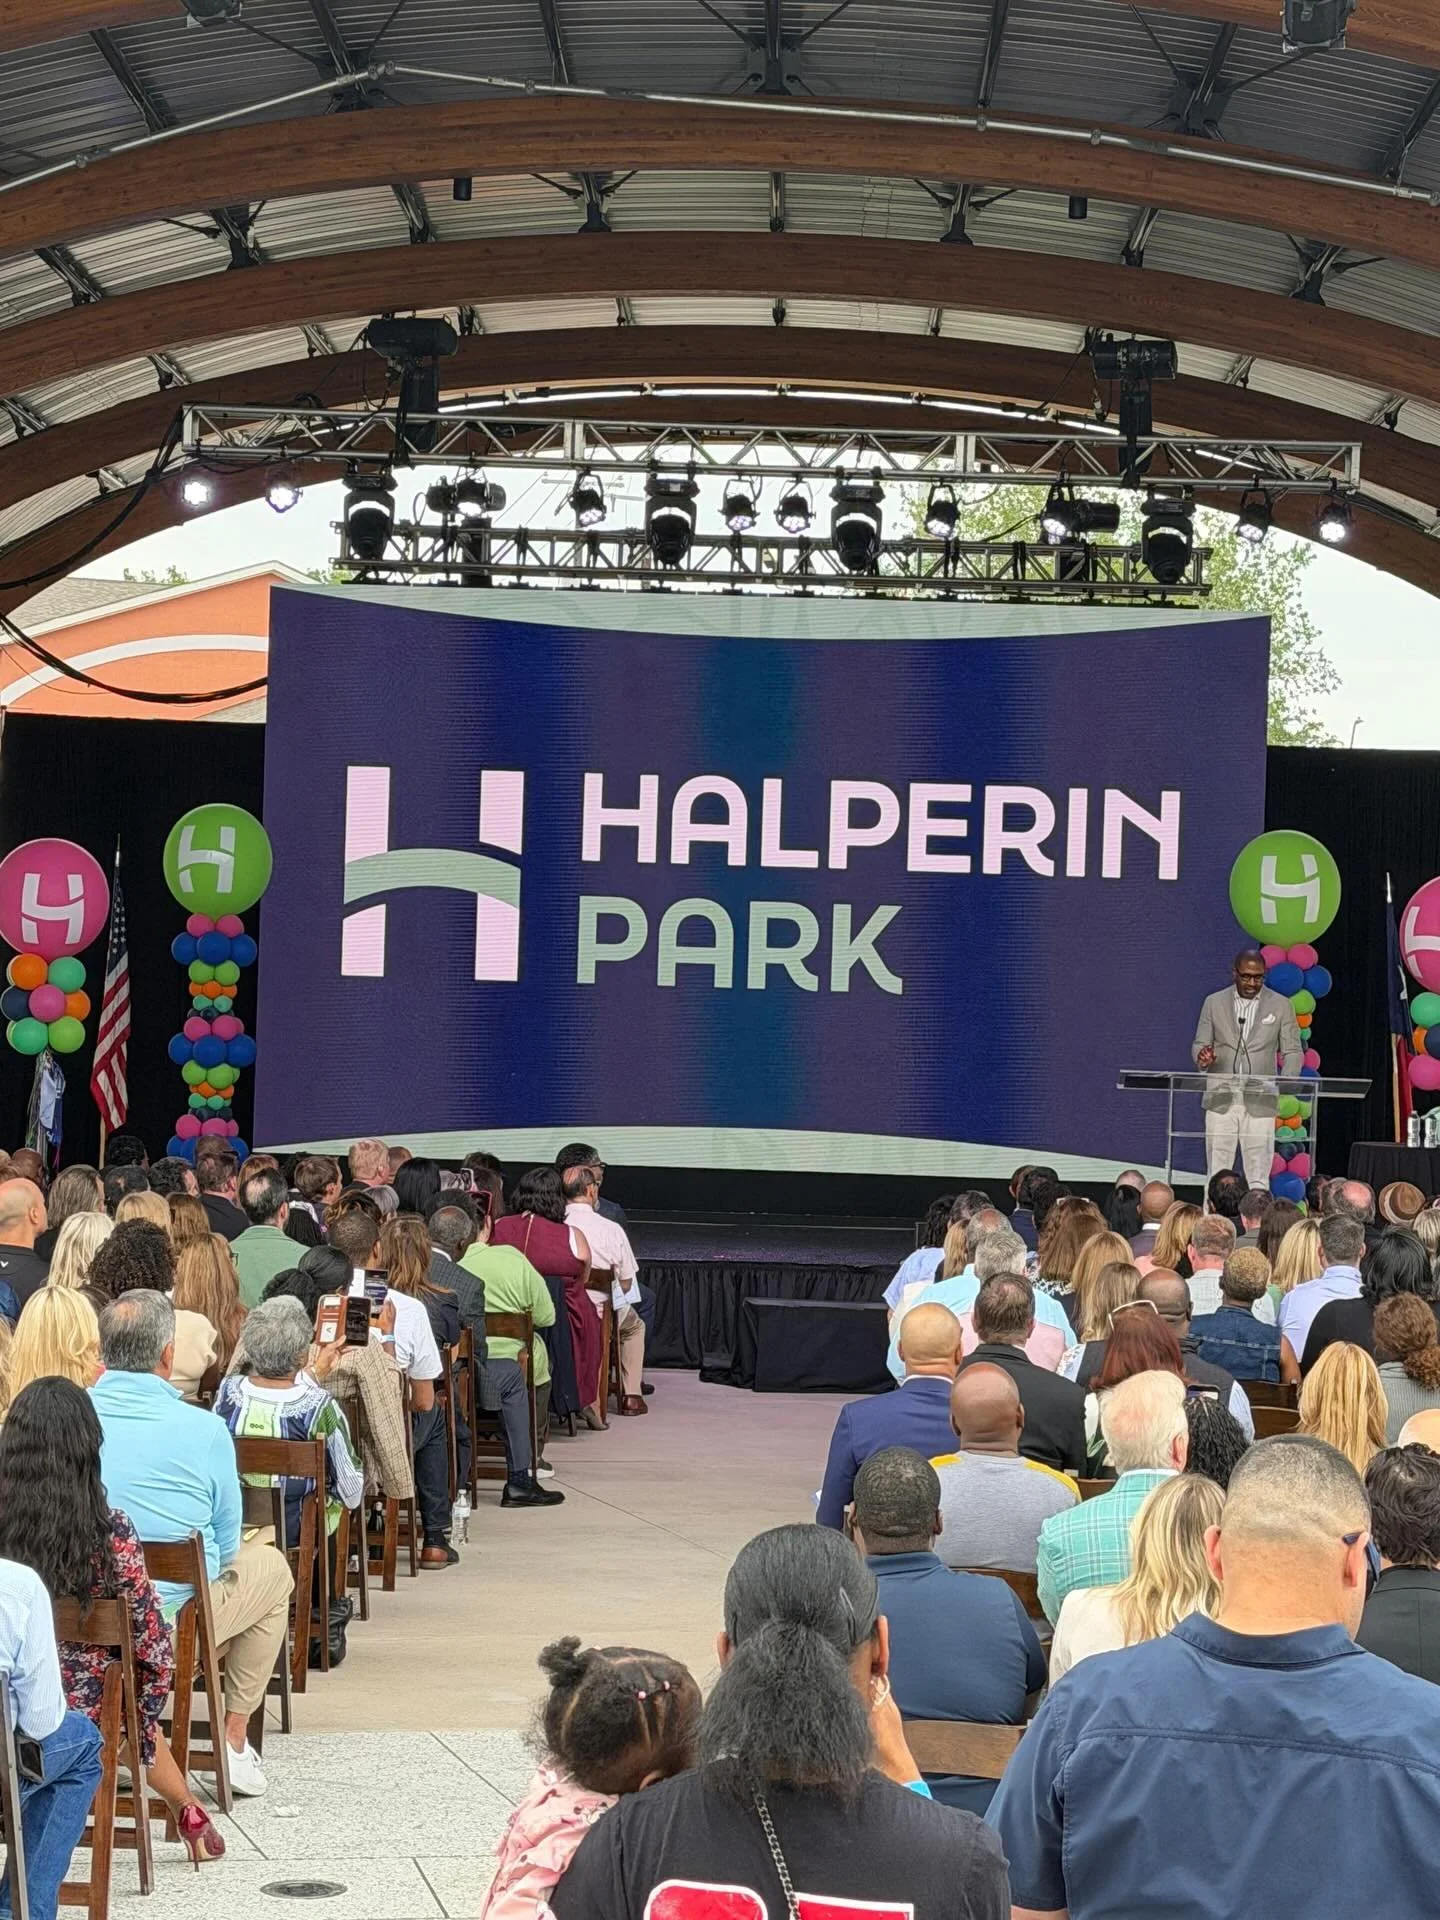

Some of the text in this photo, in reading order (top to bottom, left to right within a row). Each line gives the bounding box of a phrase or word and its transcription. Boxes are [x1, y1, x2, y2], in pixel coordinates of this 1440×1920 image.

[178, 824, 236, 894] H
[581, 772, 1180, 881] HALPERIN
[21, 872, 85, 945] H
[1260, 855, 1321, 924] H
[576, 895, 903, 995] PARK
